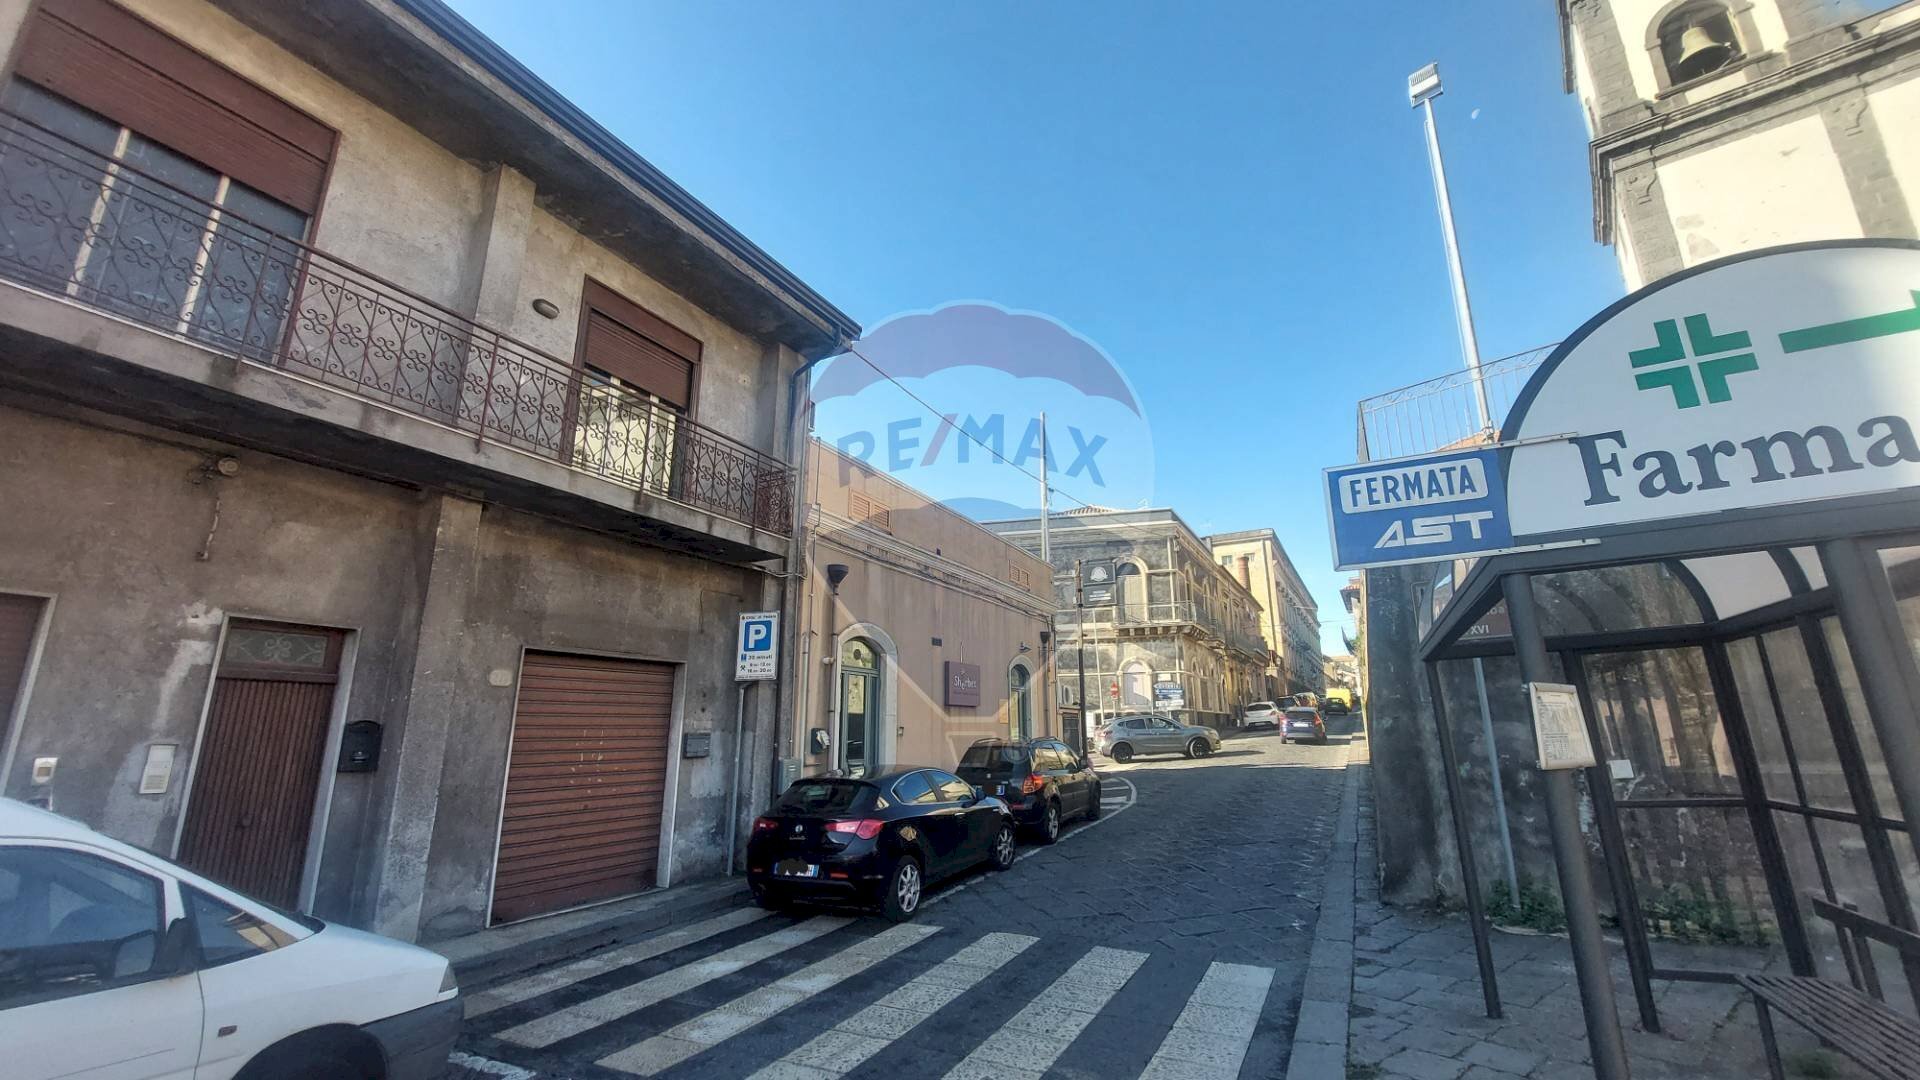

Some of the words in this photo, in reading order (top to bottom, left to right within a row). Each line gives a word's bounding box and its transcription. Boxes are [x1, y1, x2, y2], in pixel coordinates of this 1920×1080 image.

[1570, 415, 1920, 507] Farma
[1350, 463, 1477, 509] FERMATA
[1374, 510, 1494, 550] AST
[748, 624, 767, 649] P
